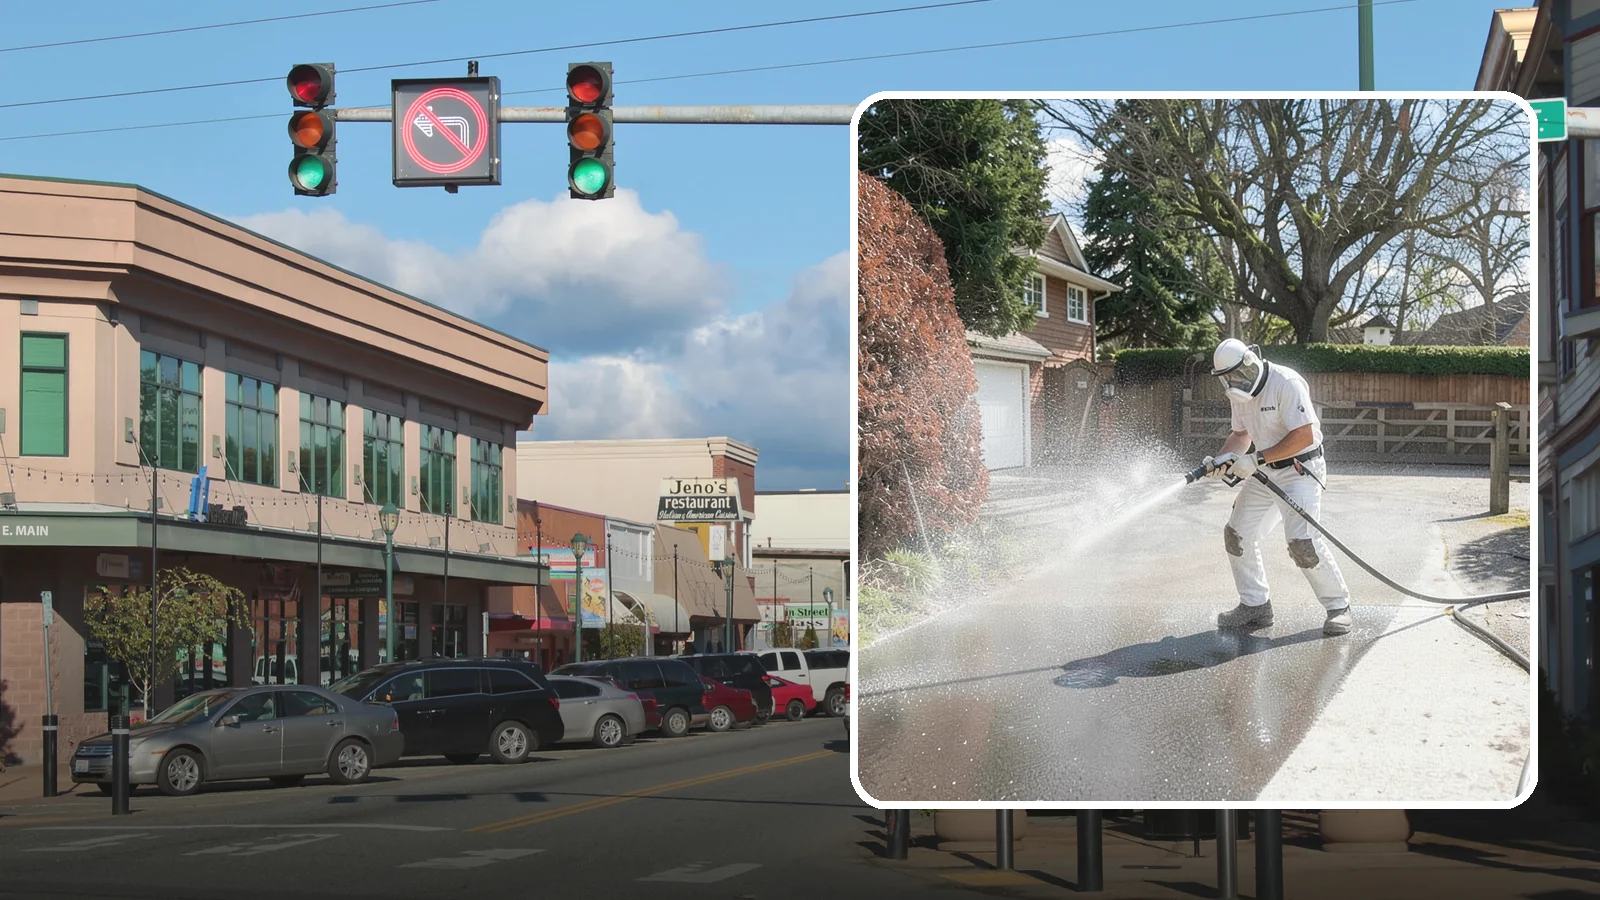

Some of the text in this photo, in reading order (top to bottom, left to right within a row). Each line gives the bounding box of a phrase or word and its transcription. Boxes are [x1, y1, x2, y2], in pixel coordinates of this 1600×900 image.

[670, 480, 727, 494] Jeno's
[665, 497, 731, 509] restaurant
[686, 510, 714, 519] American
[715, 509, 738, 519] Cuisine
[2, 525, 49, 536] E. MAIN
[797, 607, 828, 617] Street
[790, 619, 824, 627] lass
